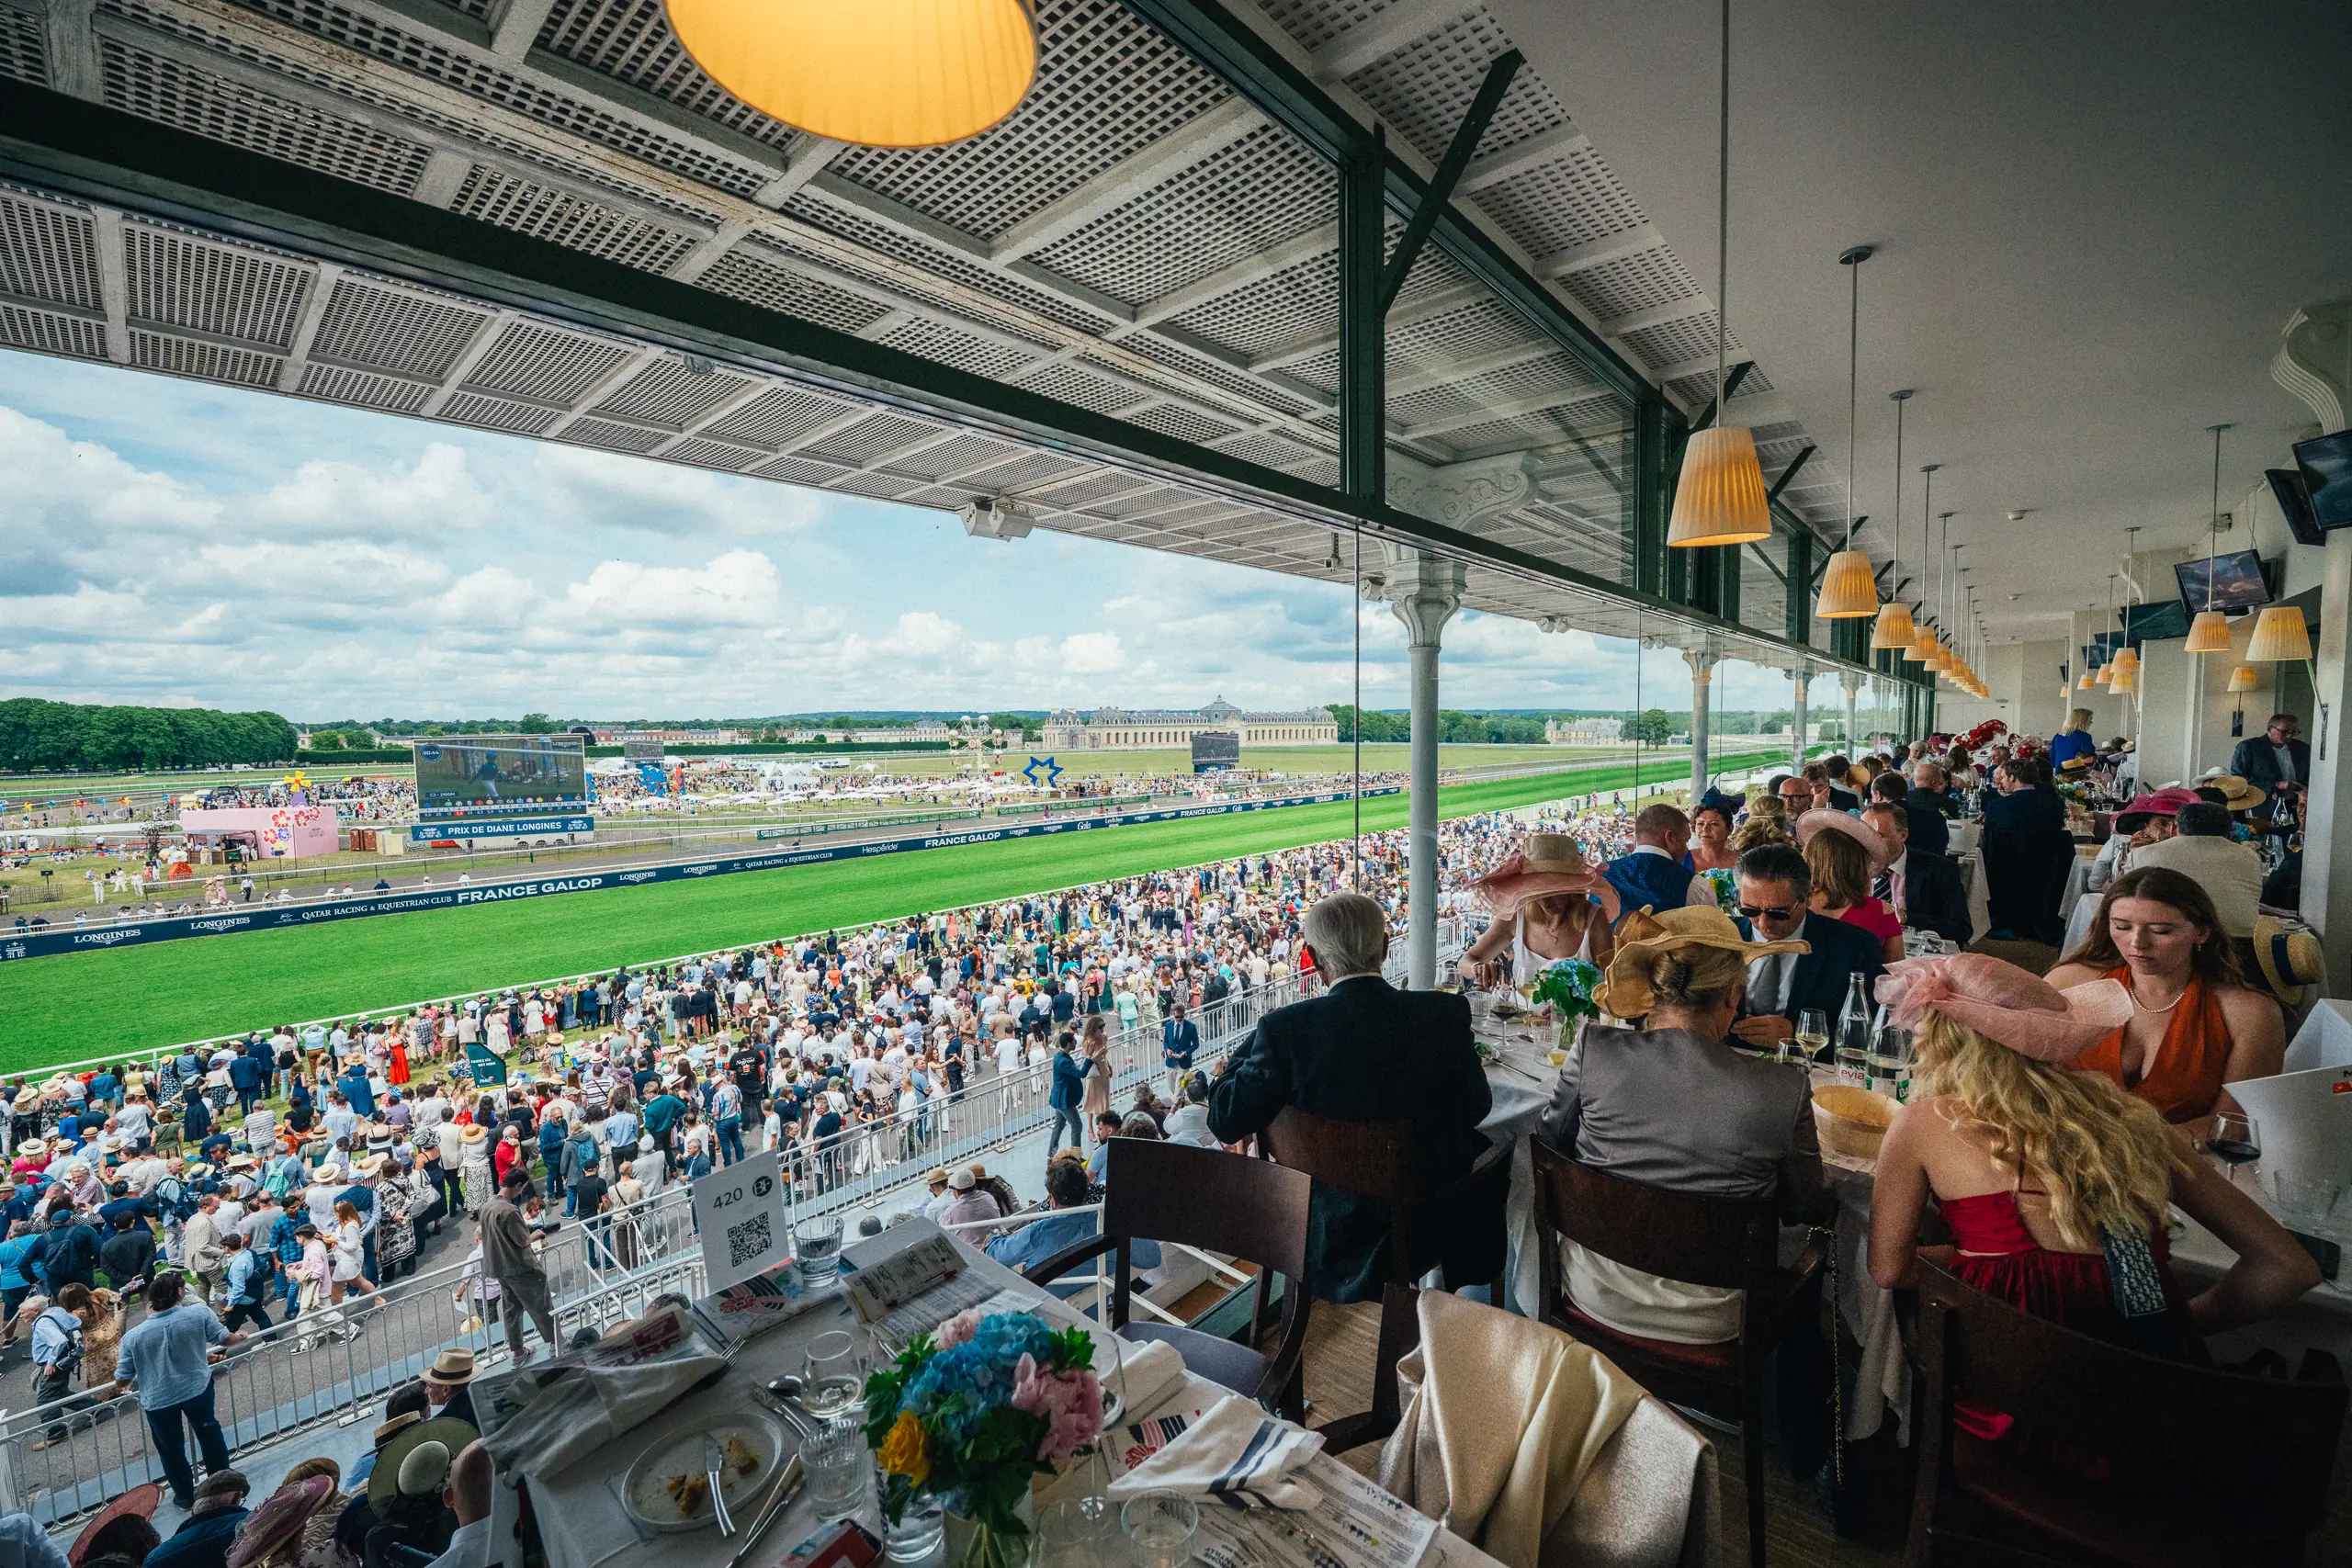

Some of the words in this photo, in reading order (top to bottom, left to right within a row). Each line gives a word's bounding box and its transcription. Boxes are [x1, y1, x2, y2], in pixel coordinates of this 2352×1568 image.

[448, 827, 469, 835] PRIX
[487, 824, 514, 833] DIANE
[517, 822, 561, 831] LONGINES
[1078, 821, 1091, 830] Gala
[925, 836, 967, 848] FRANCE
[968, 831, 1001, 842] GALOP
[789, 854, 819, 863] EQUESTRIAN
[684, 864, 717, 874] LONGINES
[620, 872, 656, 881] LONGINES
[458, 885, 537, 903] FRANCE
[541, 878, 602, 892] GALOP
[302, 909, 332, 919] QATAR
[334, 906, 368, 915] RACING
[378, 899, 429, 911] EQUESTRIAN
[431, 896, 452, 904] CLUB
[190, 917, 250, 930] LONGINES
[74, 929, 141, 943] LONGINES
[1841, 1069, 1865, 1080] evia
[713, 1187, 743, 1209] 420
